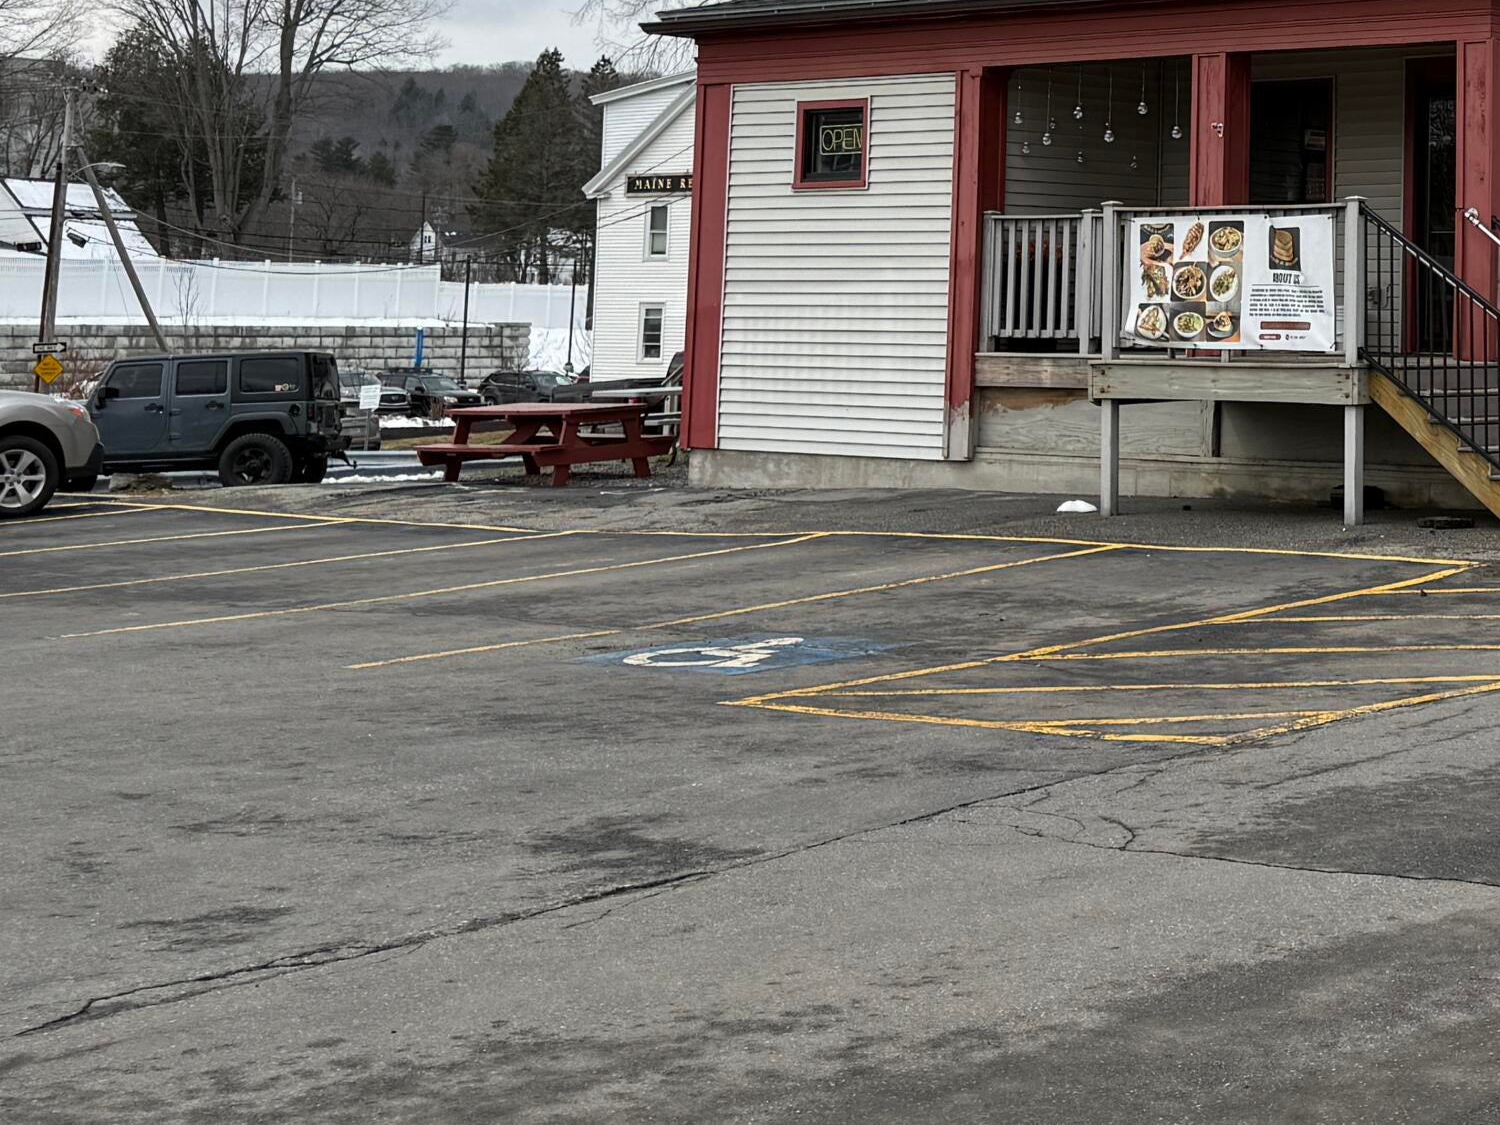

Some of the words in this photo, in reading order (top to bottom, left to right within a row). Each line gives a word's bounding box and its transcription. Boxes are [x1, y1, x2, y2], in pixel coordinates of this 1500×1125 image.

[822, 128, 863, 151] OPEN
[634, 177, 672, 190] MAINE
[1272, 272, 1292, 284] ABOUT
